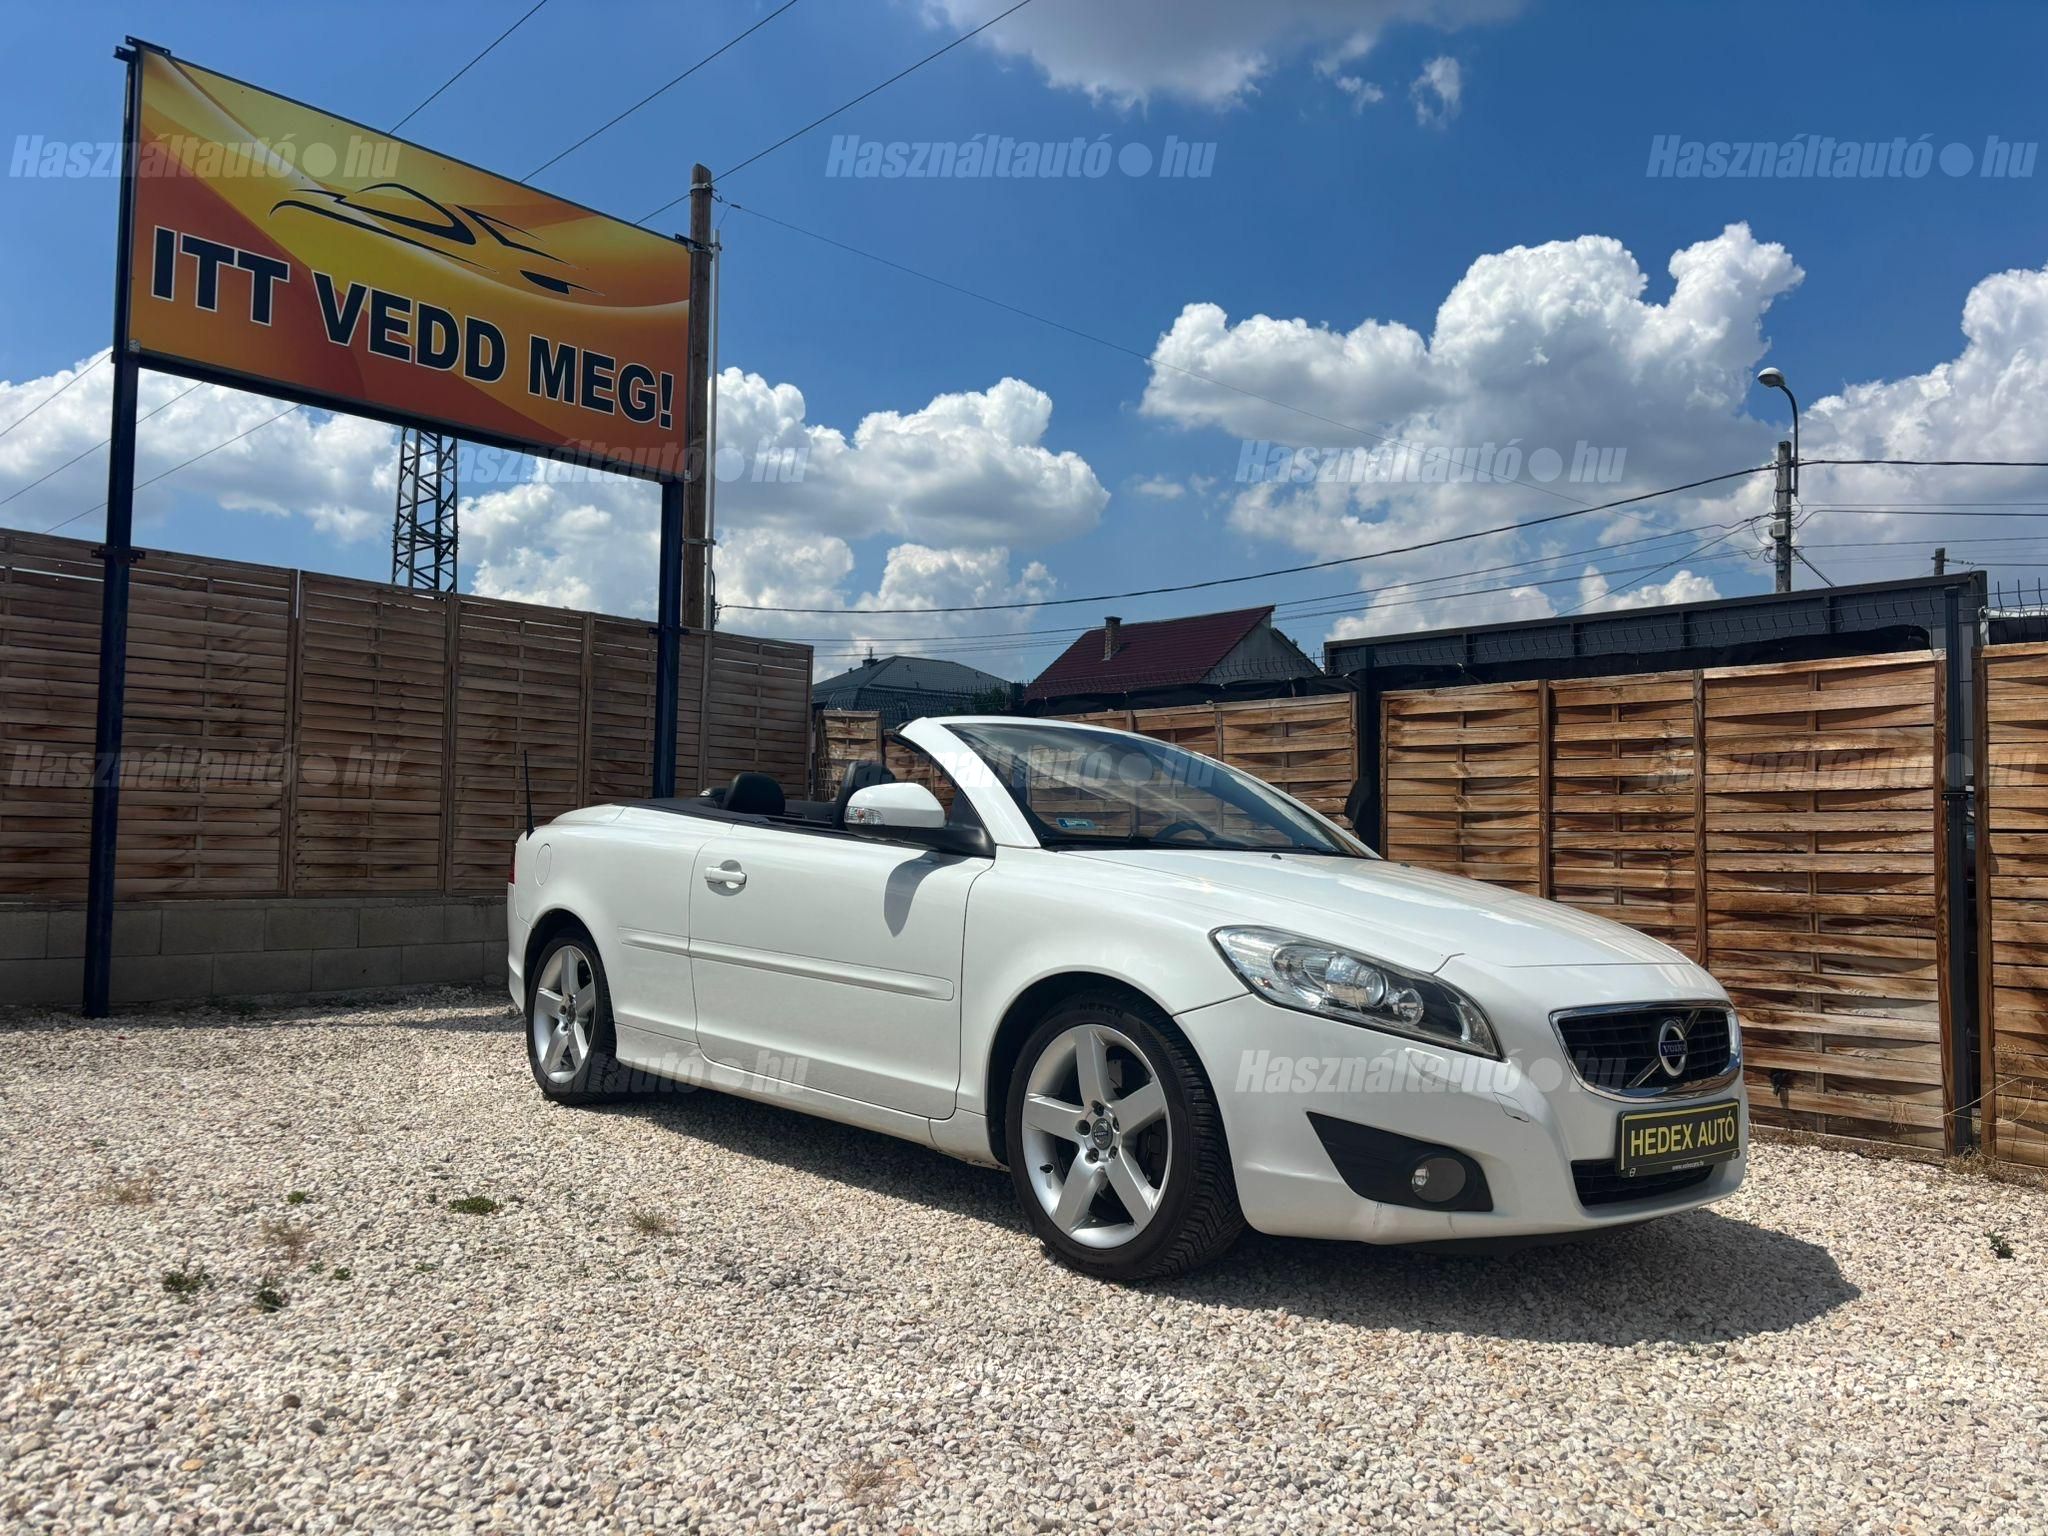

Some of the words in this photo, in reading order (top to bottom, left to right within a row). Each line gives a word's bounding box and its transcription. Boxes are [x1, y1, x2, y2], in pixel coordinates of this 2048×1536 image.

[152, 225, 290, 327] ITT
[311, 269, 507, 383] VEDD
[528, 333, 675, 430] MEG!
[1631, 1124, 1693, 1156] HEDEX
[1698, 1111, 1735, 1147] AUTÓ
